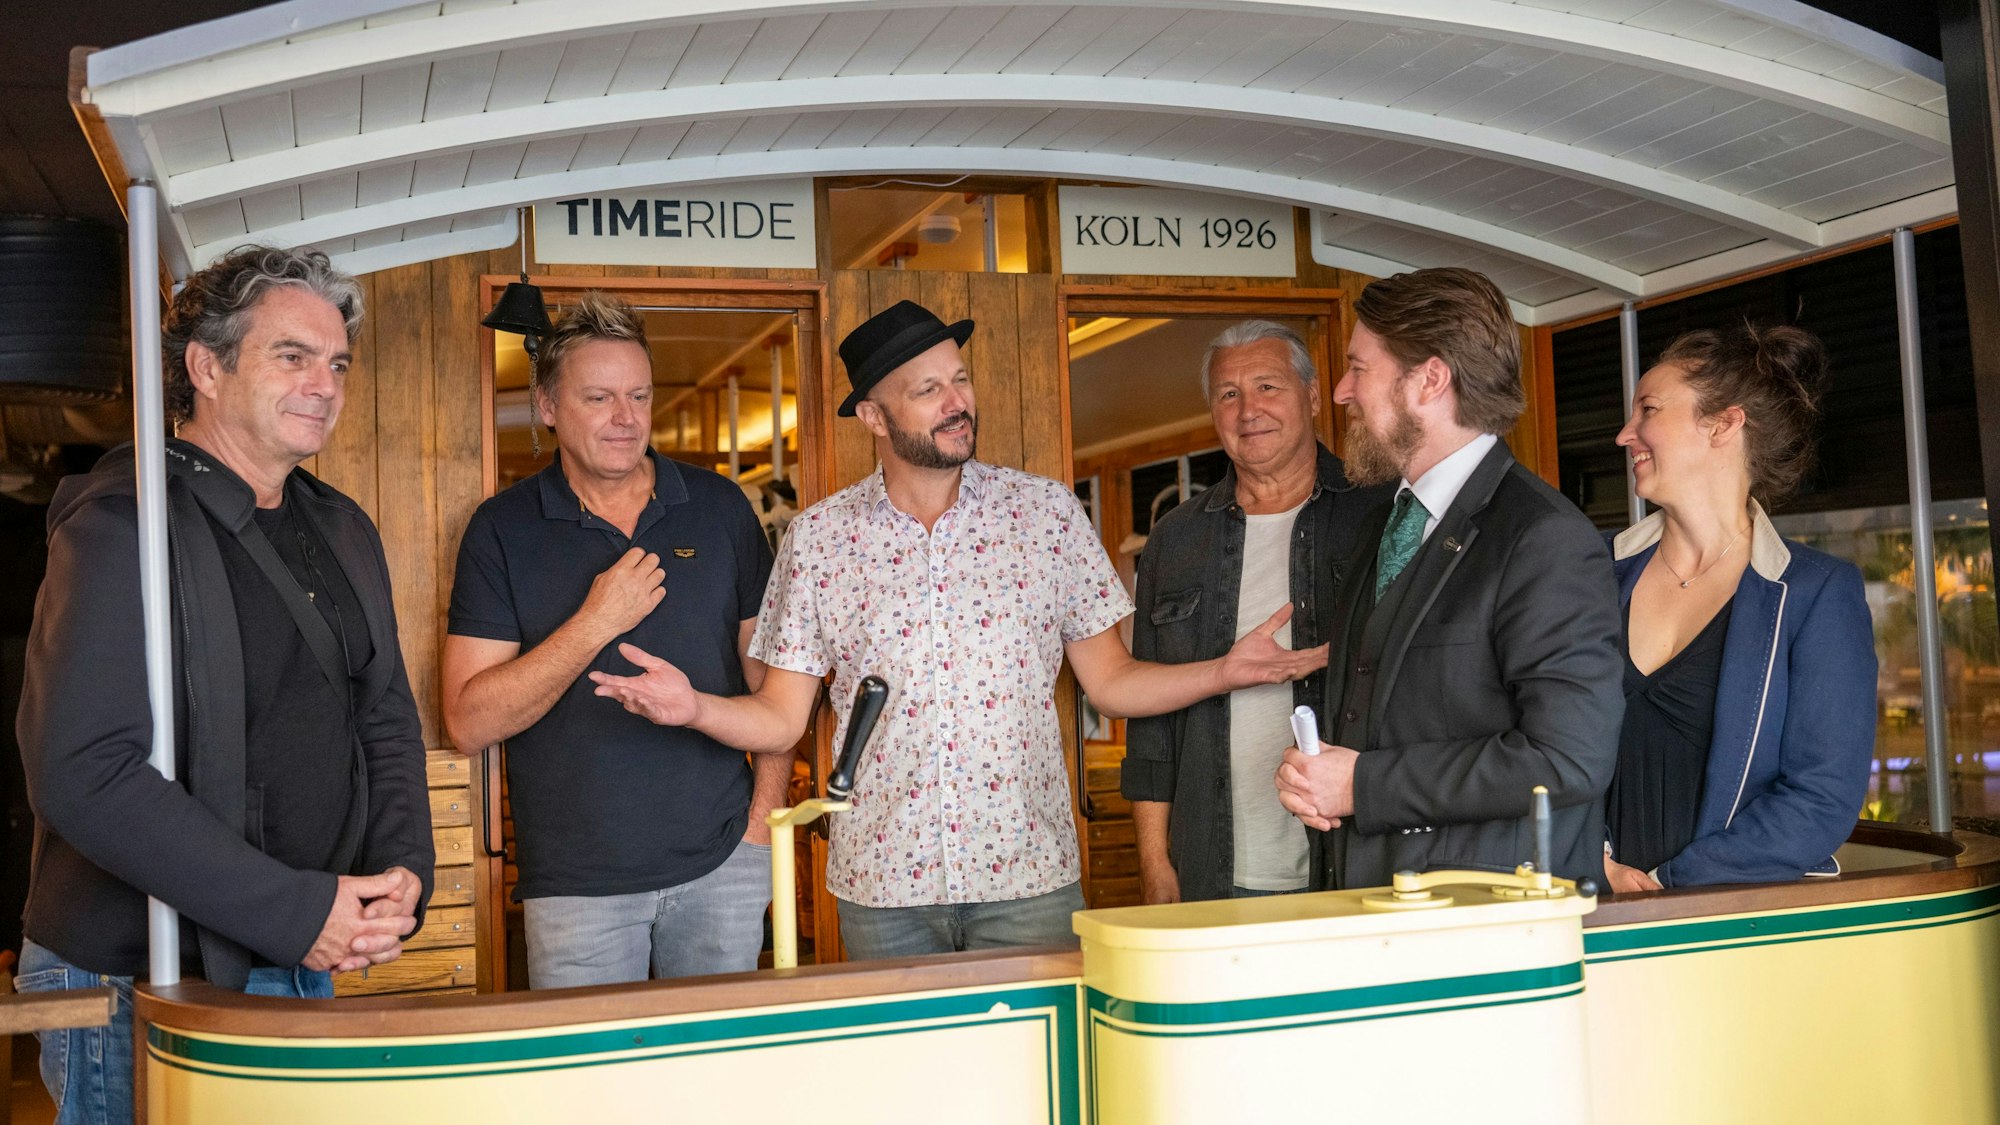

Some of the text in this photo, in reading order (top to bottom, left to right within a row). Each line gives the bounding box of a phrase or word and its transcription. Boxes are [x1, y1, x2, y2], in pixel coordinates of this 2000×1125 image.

[556, 198, 796, 240] TIMERIDE
[1075, 215, 1277, 250] KÖLN 1926
